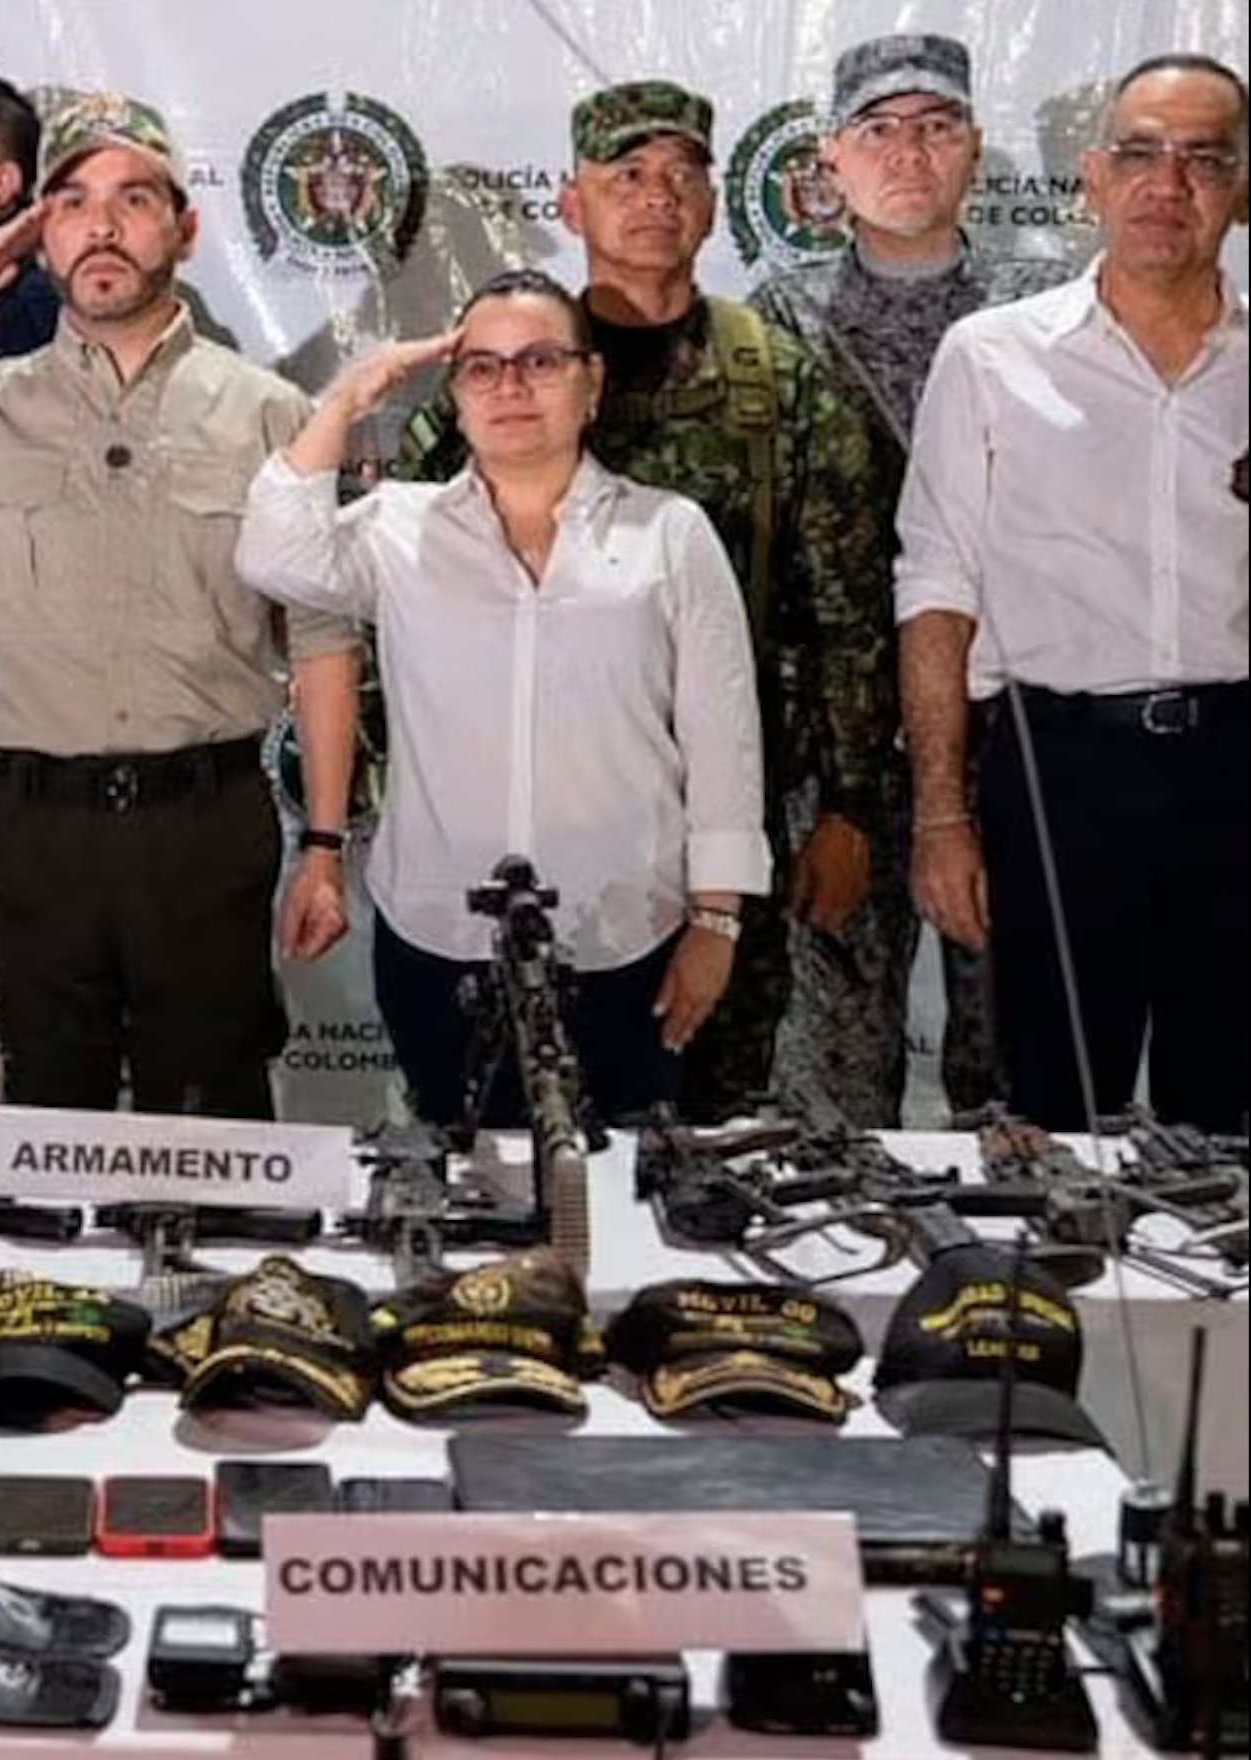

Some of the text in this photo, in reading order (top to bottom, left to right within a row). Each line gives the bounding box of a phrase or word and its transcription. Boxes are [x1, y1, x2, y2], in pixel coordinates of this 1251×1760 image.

[286, 1050, 397, 1071] COLOMB
[11, 1141, 293, 1183] ARMAMENTO
[279, 1555, 809, 1595] COMUNICACIONES
